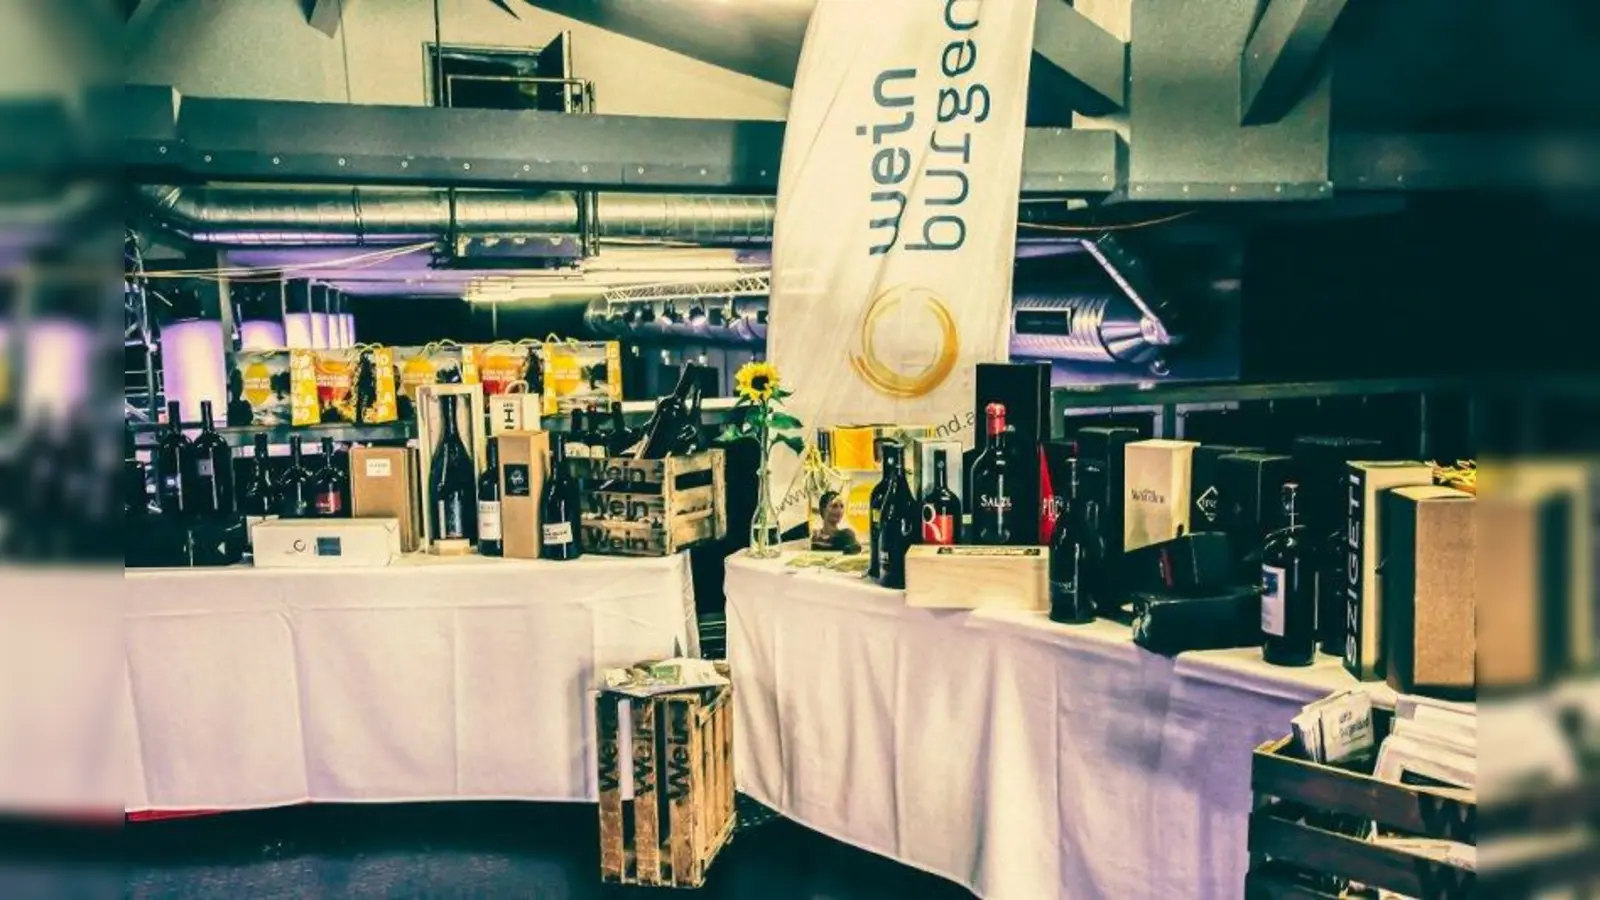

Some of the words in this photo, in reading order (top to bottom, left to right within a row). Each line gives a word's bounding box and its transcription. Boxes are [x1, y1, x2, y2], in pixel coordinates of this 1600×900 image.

[856, 68, 918, 256] wein
[587, 494, 649, 517] Wein
[1345, 474, 1361, 667] SZIGETI
